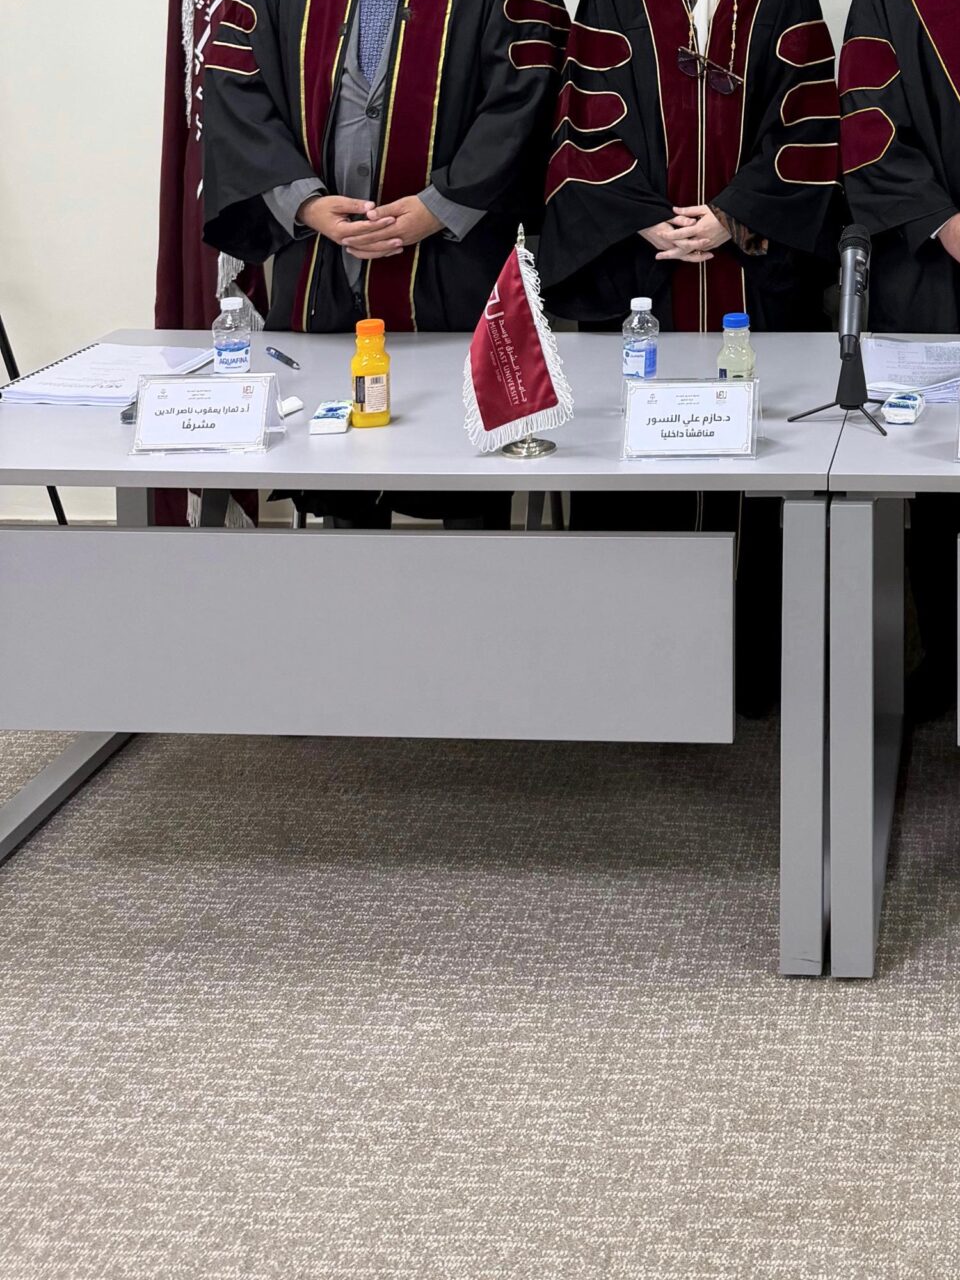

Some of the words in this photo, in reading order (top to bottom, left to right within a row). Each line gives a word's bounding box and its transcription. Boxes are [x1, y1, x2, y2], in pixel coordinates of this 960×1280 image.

[218, 356, 249, 366] AQUAFINA
[489, 321, 502, 346] MIDDLE
[497, 346, 508, 363] EAST
[503, 364, 520, 405] UNIVERSITY
[154, 408, 175, 417] الدين
[175, 407, 194, 416] ناصر
[194, 407, 222, 416] يعقوب
[646, 414, 681, 426] النسور
[682, 414, 700, 426] علي
